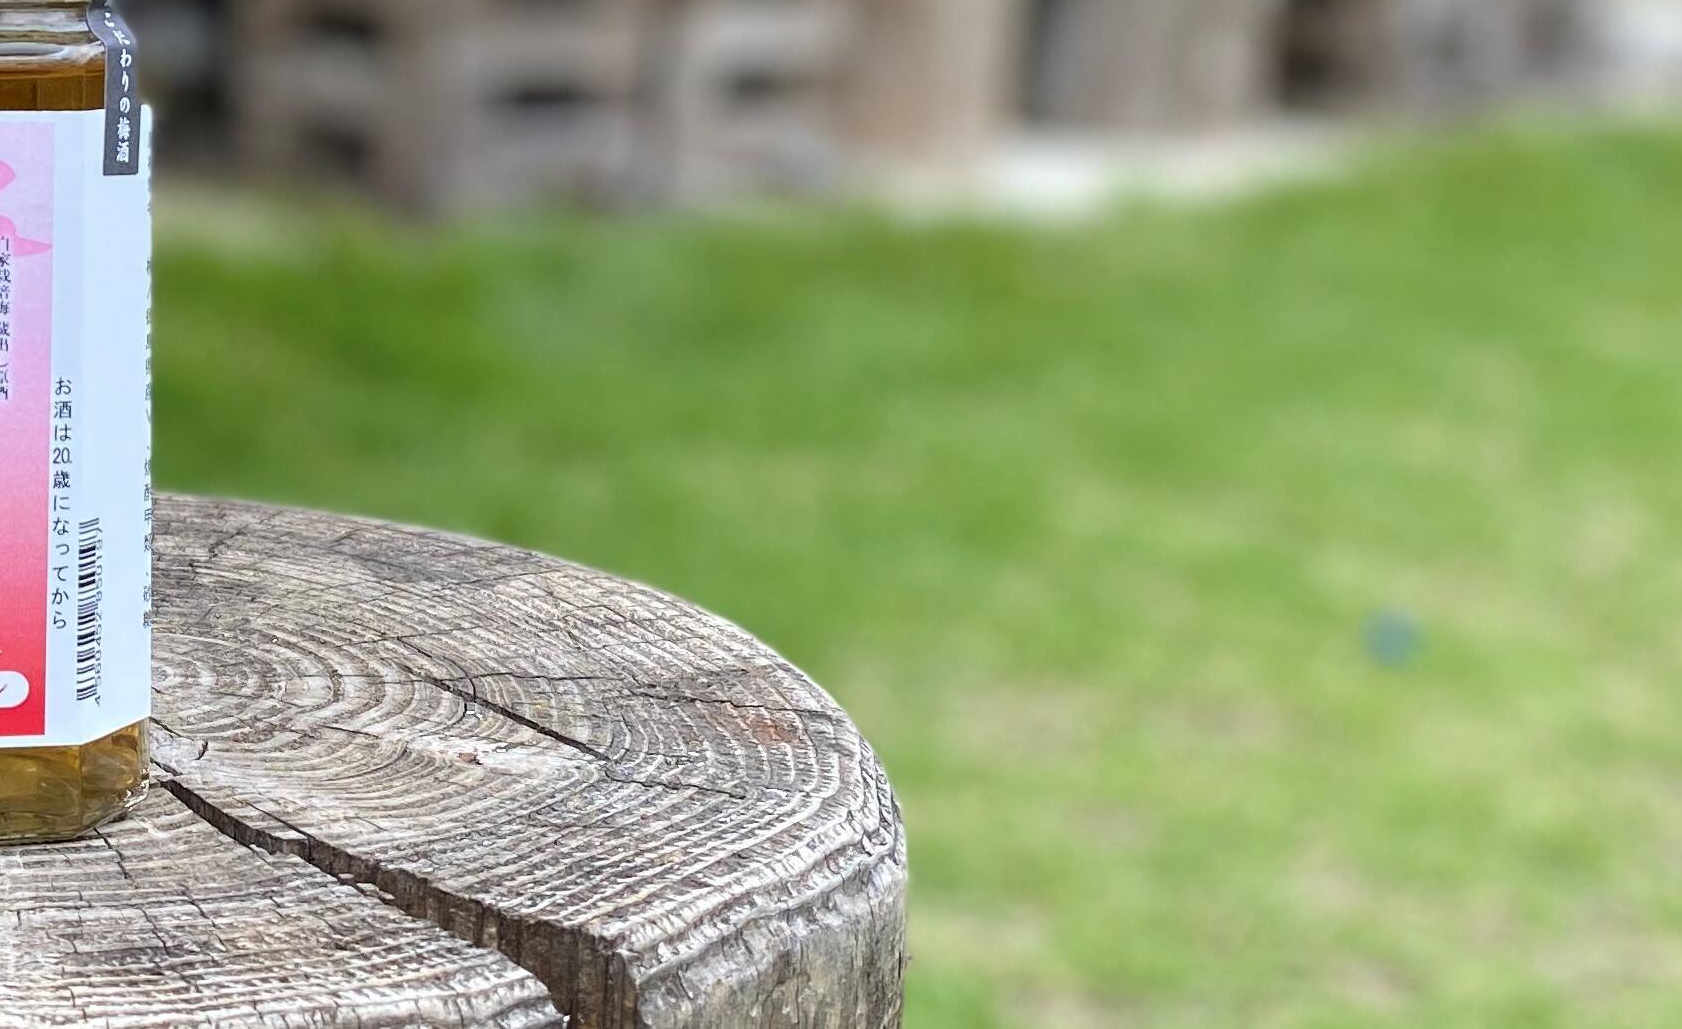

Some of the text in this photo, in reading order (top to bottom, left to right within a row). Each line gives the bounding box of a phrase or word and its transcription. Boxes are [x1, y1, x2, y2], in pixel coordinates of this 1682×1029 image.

[51, 377, 73, 630] お酒は20歳になってから
